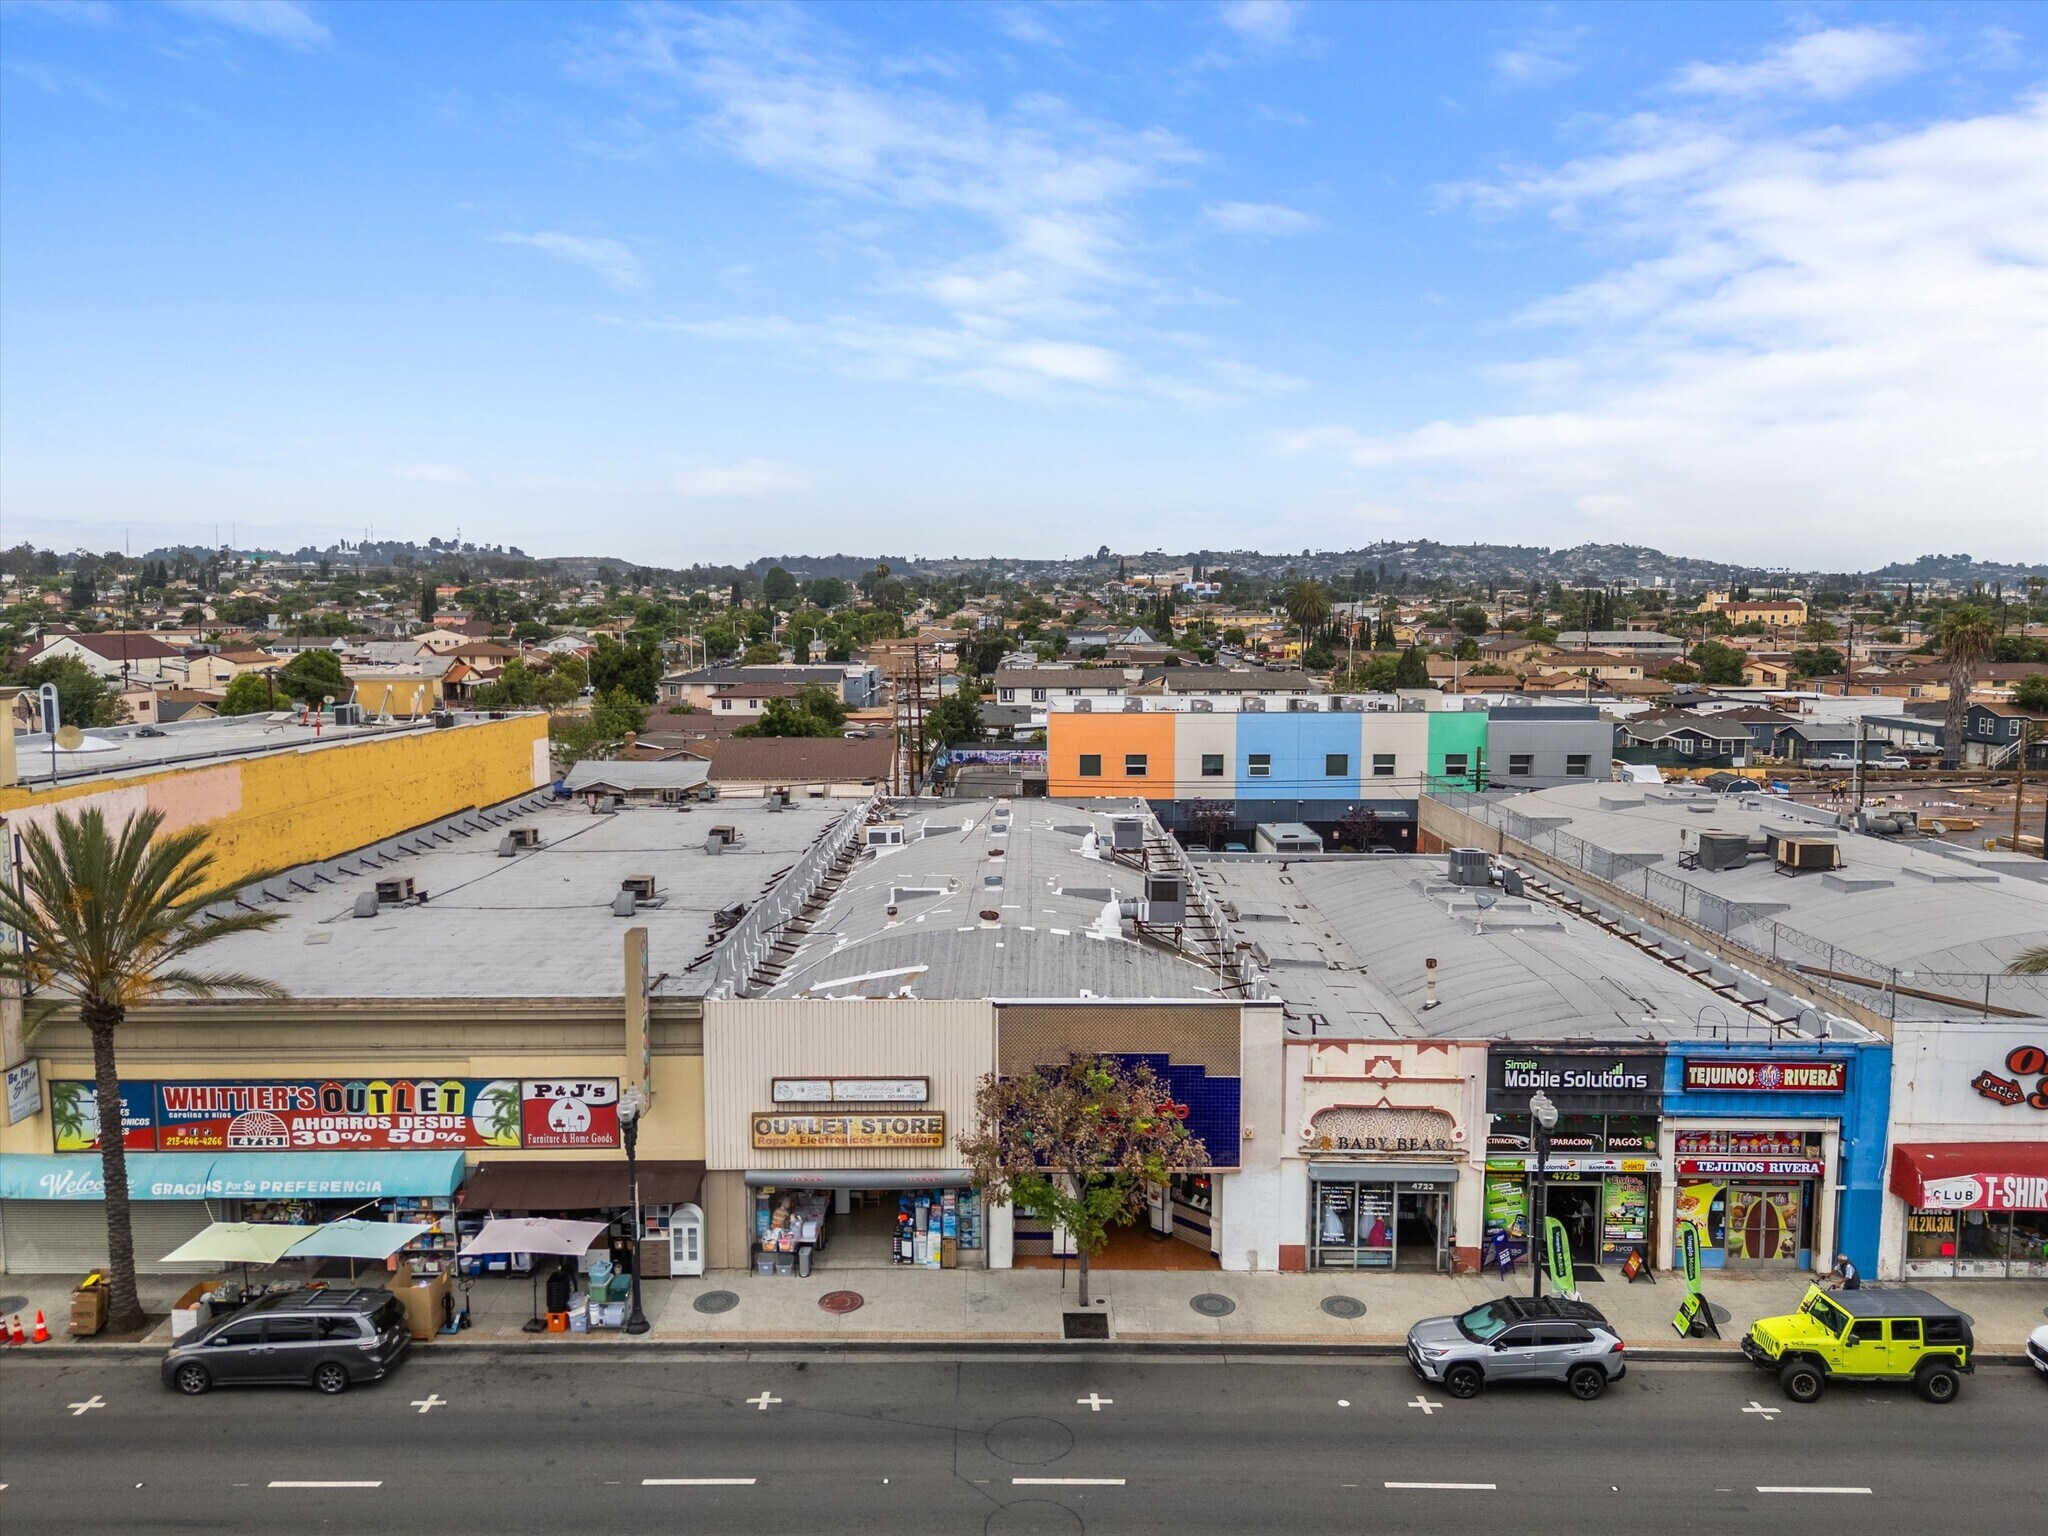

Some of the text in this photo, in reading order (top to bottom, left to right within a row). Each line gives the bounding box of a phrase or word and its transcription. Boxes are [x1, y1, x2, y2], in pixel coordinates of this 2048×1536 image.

[1504, 1059, 1538, 1072] Simple
[8, 1072, 18, 1086] Be
[1504, 1069, 1648, 1089] Mobile Solutions
[1689, 1066, 1838, 1087] TEJUINOS RIVERA
[534, 1083, 606, 1098] P & J's
[162, 1086, 461, 1113] WHITTIER'S OUTLET
[168, 1111, 202, 1119] Carolina
[291, 1117, 466, 1131] AHORROS DESDE
[755, 1118, 942, 1135] OUTLET STORE
[166, 1136, 222, 1146] 213-646-4266
[239, 1137, 278, 1145] 4713
[292, 1129, 466, 1144] 30% 50%
[528, 1132, 613, 1144] Furniture & Home Goods
[757, 1136, 786, 1146] Ropa
[885, 1134, 939, 1144] Furniture
[1608, 1137, 1642, 1147] PAGOS
[1338, 1137, 1447, 1149] BABY BEAR
[1697, 1162, 1819, 1172] TEJUINOS RIVERA
[1552, 1172, 1580, 1180] 4725
[151, 1180, 222, 1195] GRACIAS
[260, 1181, 382, 1192] PREFERENCIA
[1412, 1182, 1434, 1190] 4723
[1933, 1190, 1974, 1201] CLUB
[1919, 1216, 1937, 1232] 2XL
[1937, 1216, 1955, 1232] 3XL
